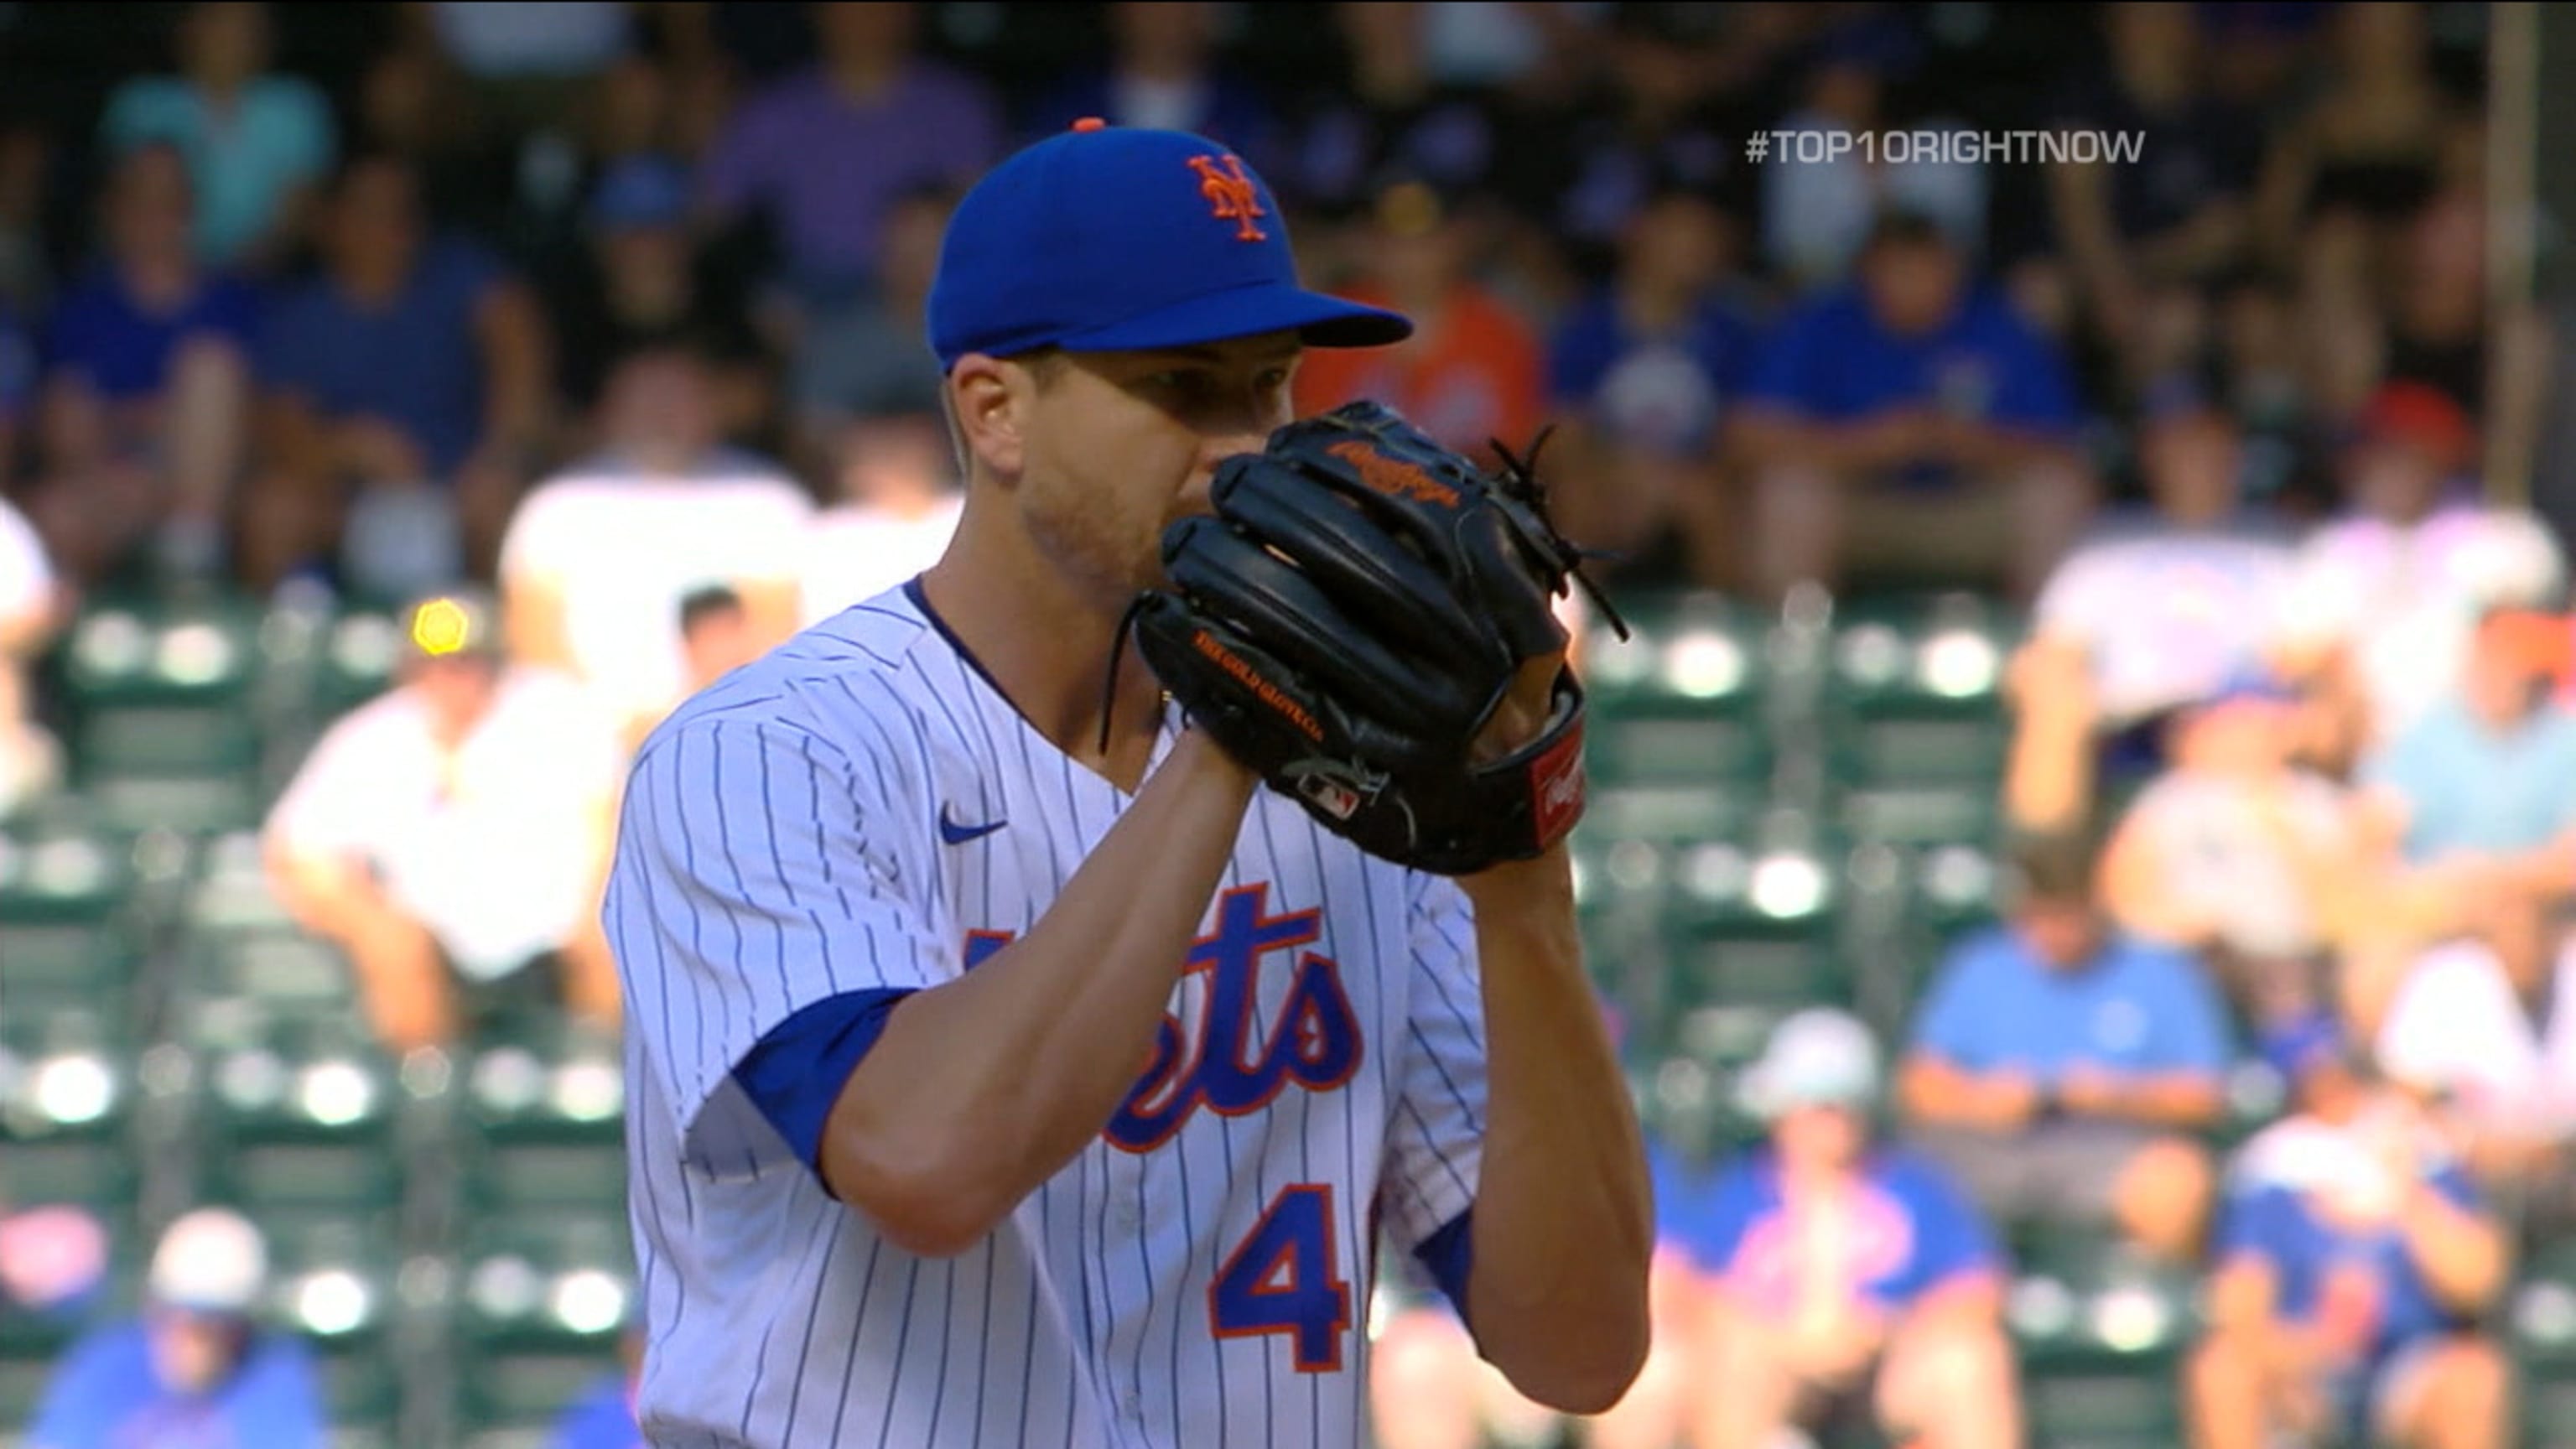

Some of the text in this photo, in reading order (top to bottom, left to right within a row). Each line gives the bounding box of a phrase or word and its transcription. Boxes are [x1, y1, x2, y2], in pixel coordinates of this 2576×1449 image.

[1186, 153, 1266, 241] NY
[963, 880, 1364, 1154] ets
[1207, 1183, 1352, 1374] 4
